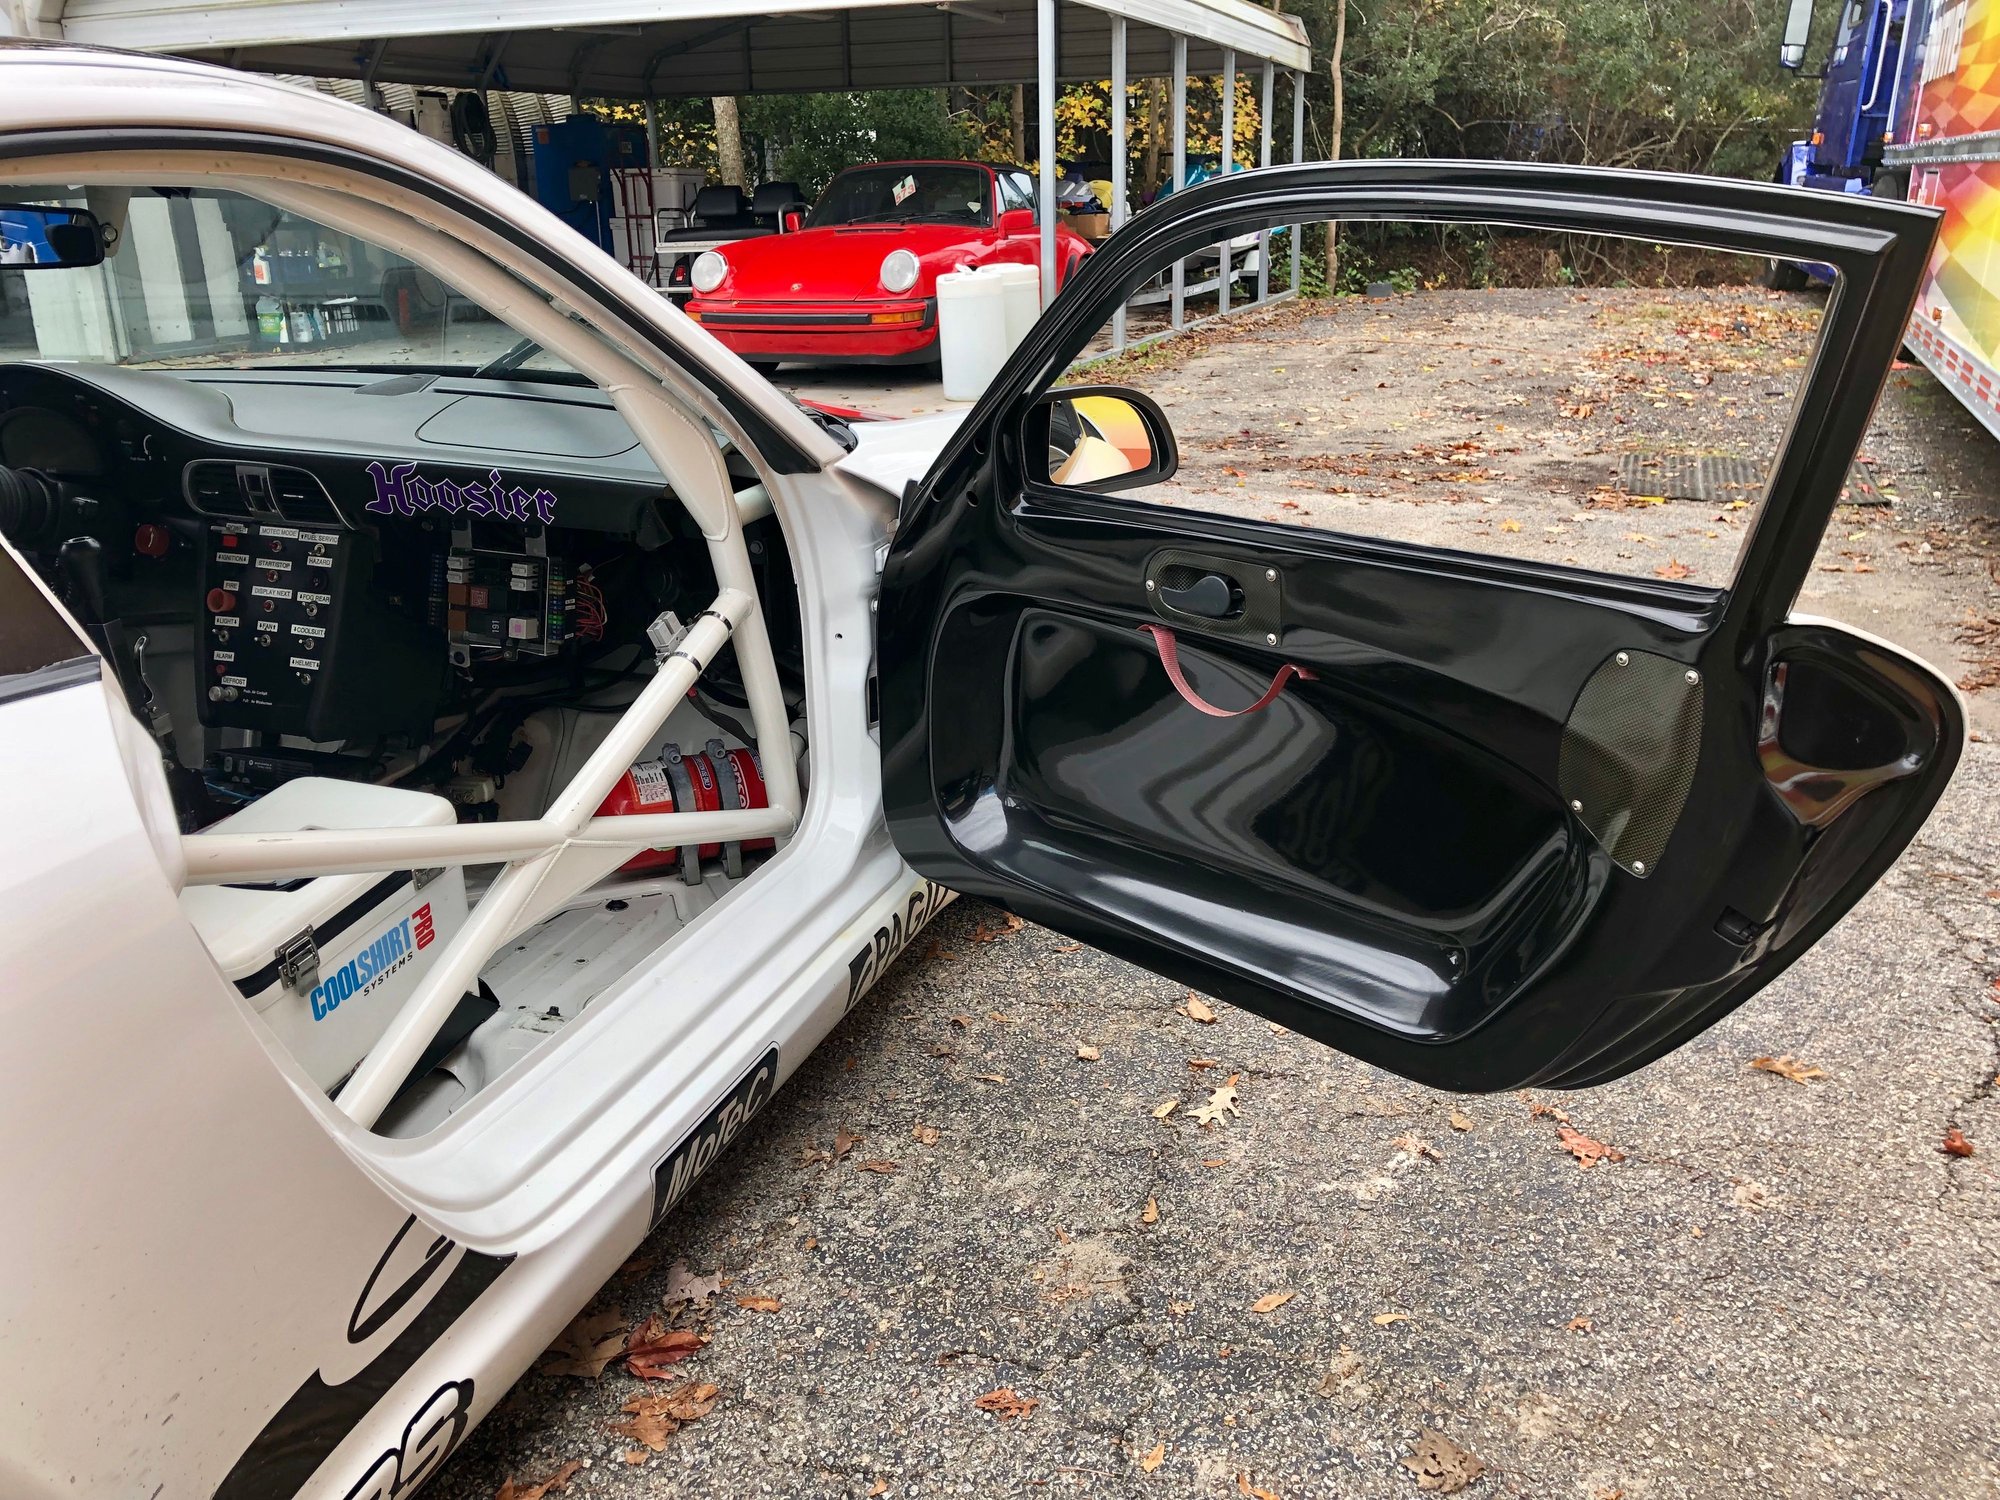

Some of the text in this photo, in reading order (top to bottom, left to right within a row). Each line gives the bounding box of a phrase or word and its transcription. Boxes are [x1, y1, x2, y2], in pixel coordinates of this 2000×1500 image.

[365, 460, 558, 526] Hoosier
[261, 527, 297, 537] MOTEC MODE
[304, 533, 317, 542] FUEL
[220, 553, 244, 562] IGNITION
[308, 558, 331, 566] HAZARD
[254, 588, 276, 596] DISPLAY
[302, 593, 330, 603] FOG REAR
[219, 617, 235, 625] LIGHT
[262, 623, 273, 631] FAN
[296, 626, 324, 636] COOLSUIT
[294, 659, 316, 668] HELMET
[223, 677, 246, 686] DEFROST
[411, 902, 436, 951] PRO
[309, 916, 412, 1022] COOLSHIRT
[363, 951, 413, 997] SYSTEMS
[660, 1066, 769, 1216] MoTeC
